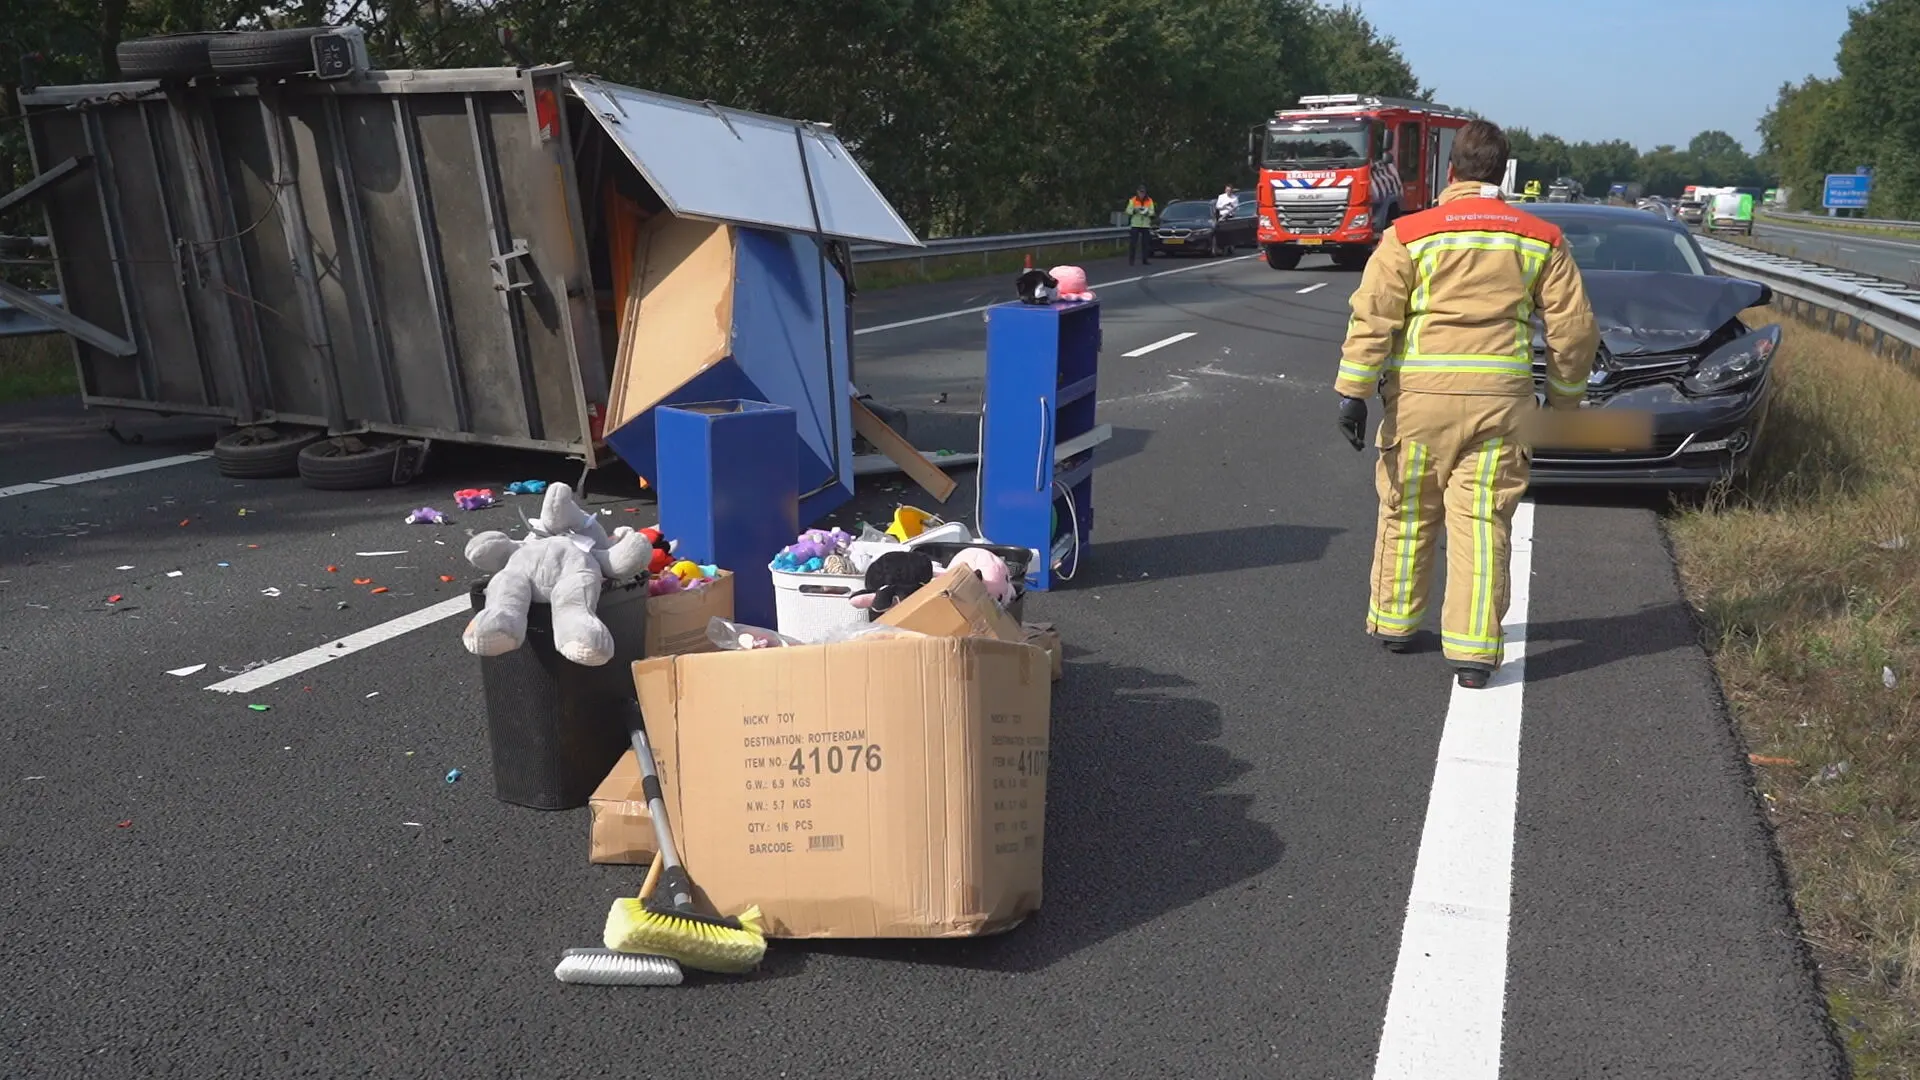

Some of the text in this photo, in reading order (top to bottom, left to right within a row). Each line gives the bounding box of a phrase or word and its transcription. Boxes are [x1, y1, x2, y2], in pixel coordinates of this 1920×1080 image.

[743, 713, 795, 725] NICKY TOY
[744, 730, 865, 747] DESTINATION: ROTTERDAM
[745, 758, 765, 768] ITEM
[789, 744, 882, 775] 41076
[1018, 750, 1047, 776] 4107
[792, 777, 811, 787] KGS
[773, 800, 784, 810] 5.7
[793, 799, 811, 809] KGS
[795, 820, 813, 830] PCS
